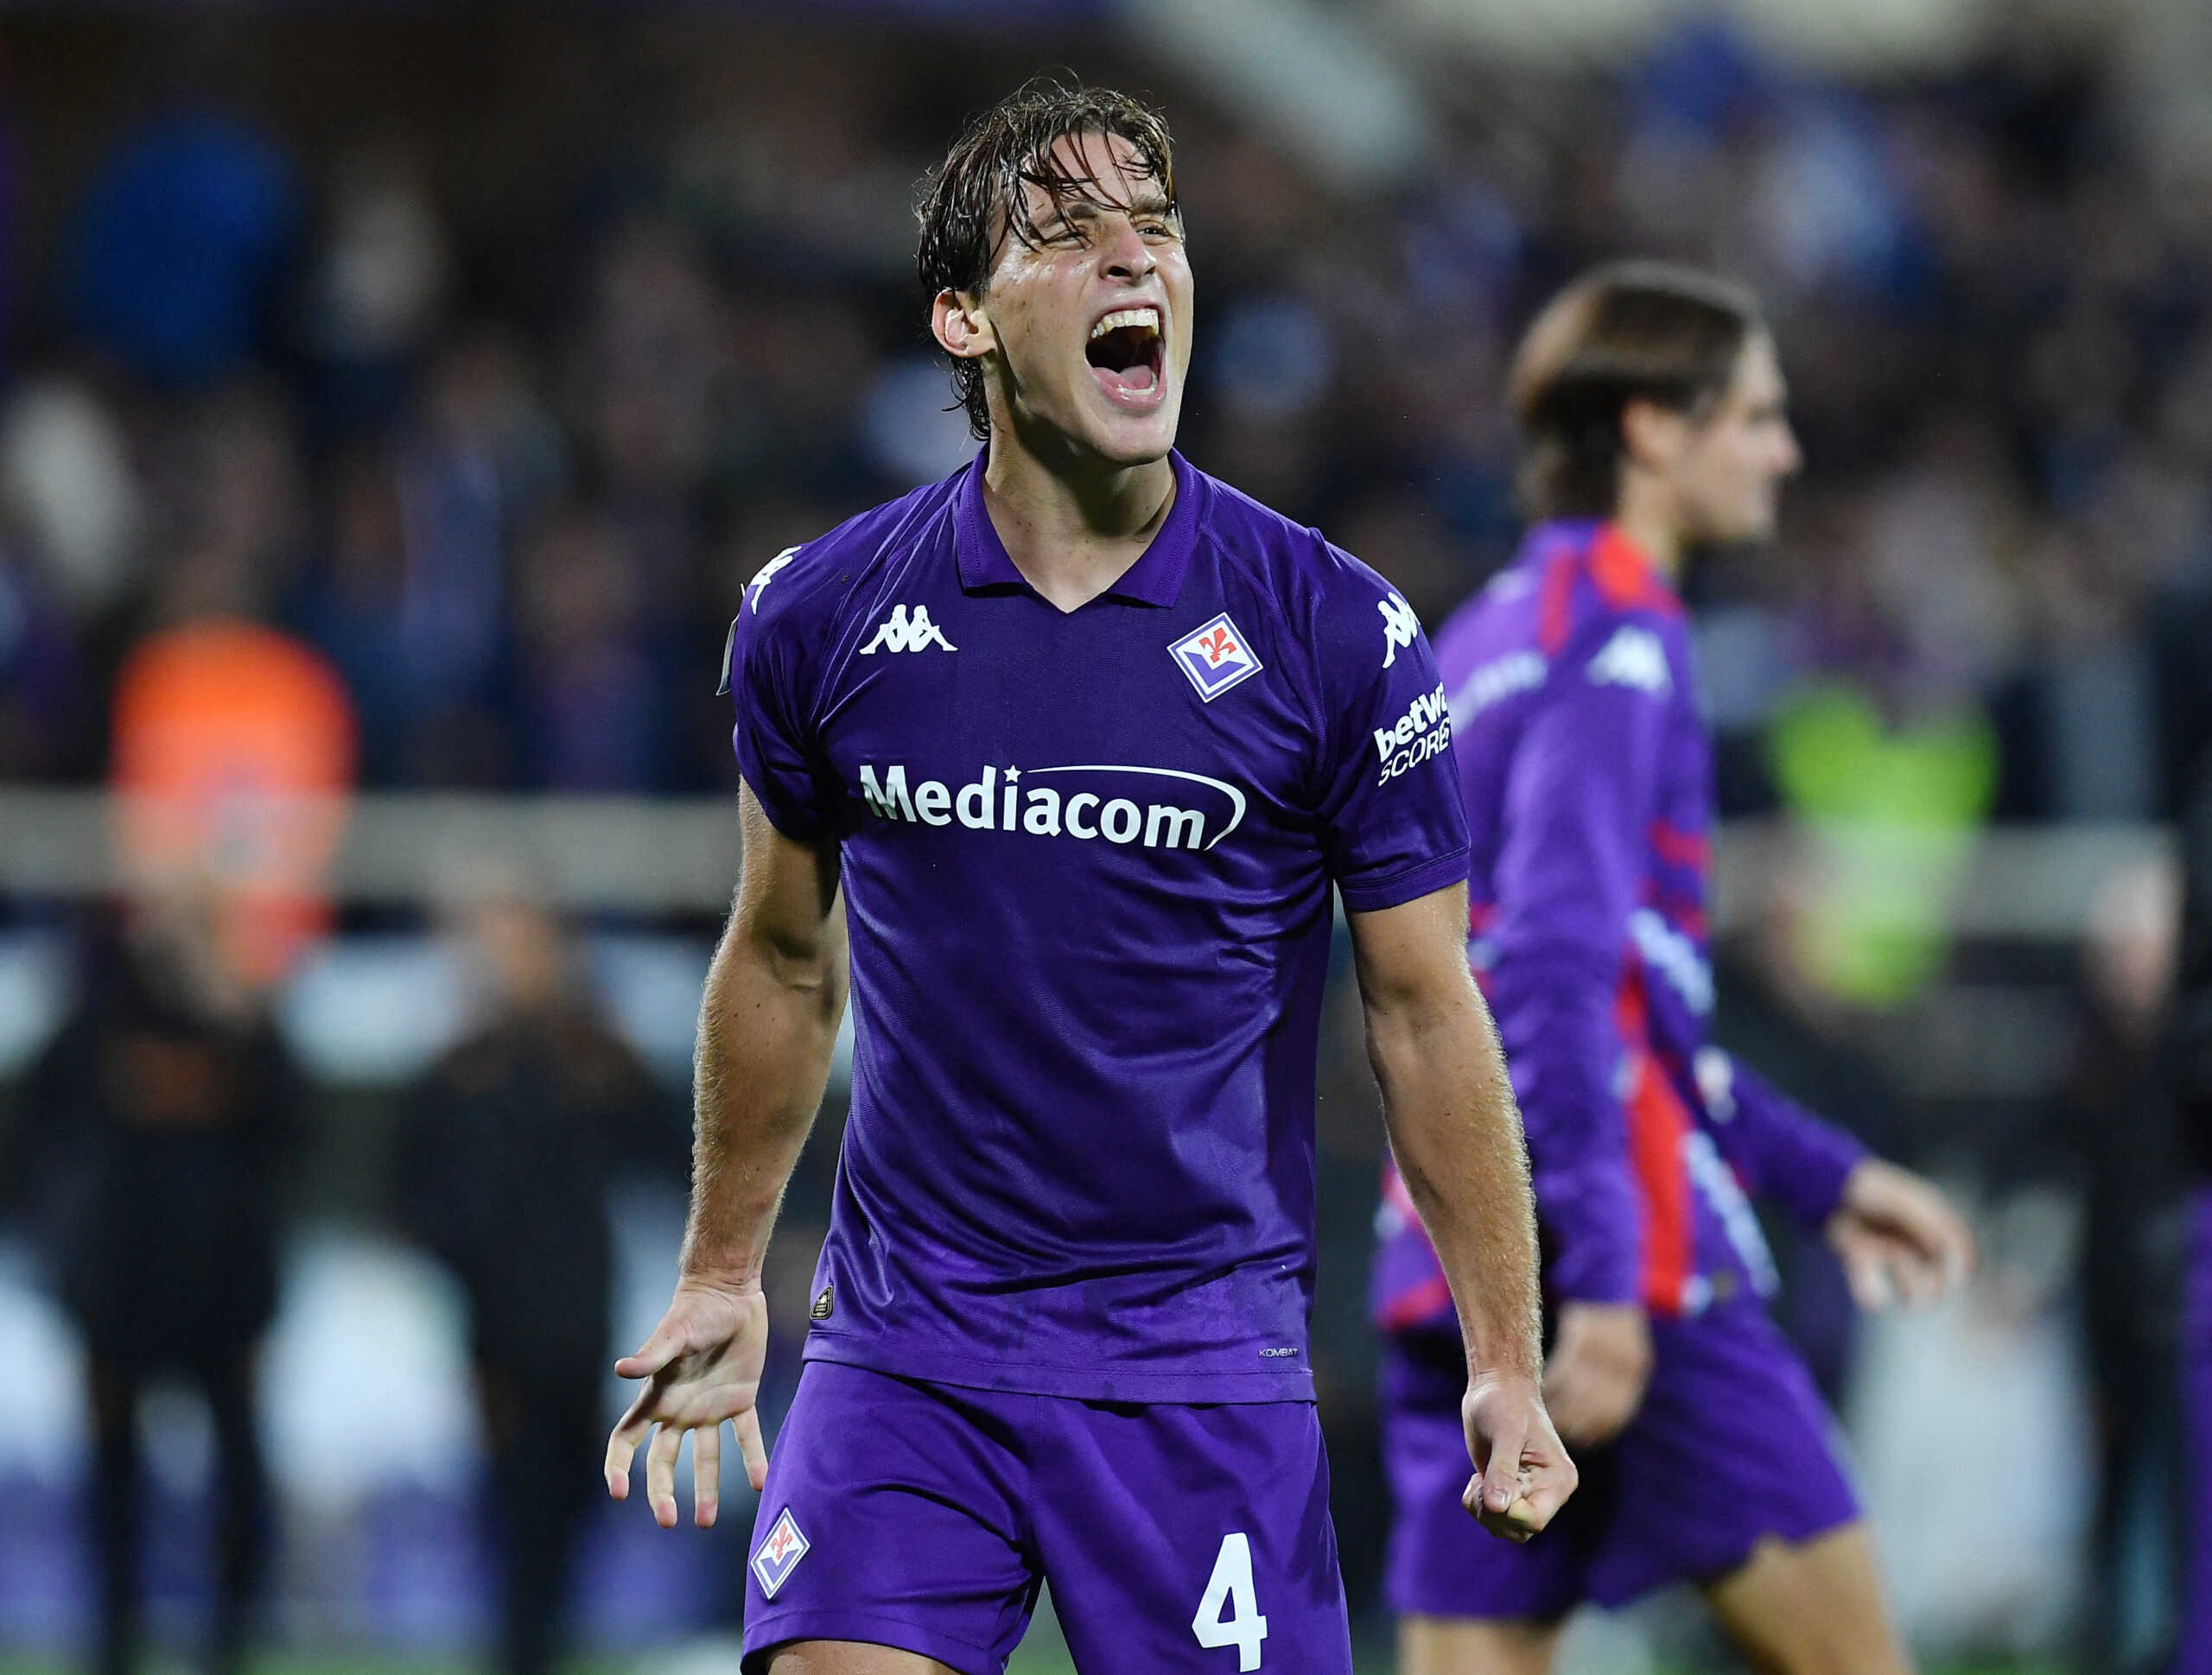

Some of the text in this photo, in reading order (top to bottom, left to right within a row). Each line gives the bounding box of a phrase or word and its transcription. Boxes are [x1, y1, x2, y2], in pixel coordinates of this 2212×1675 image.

[859, 765, 1205, 850] Mediacom
[1258, 1348, 1299, 1357] KOMBAT
[1192, 1532, 1268, 1673] 4
